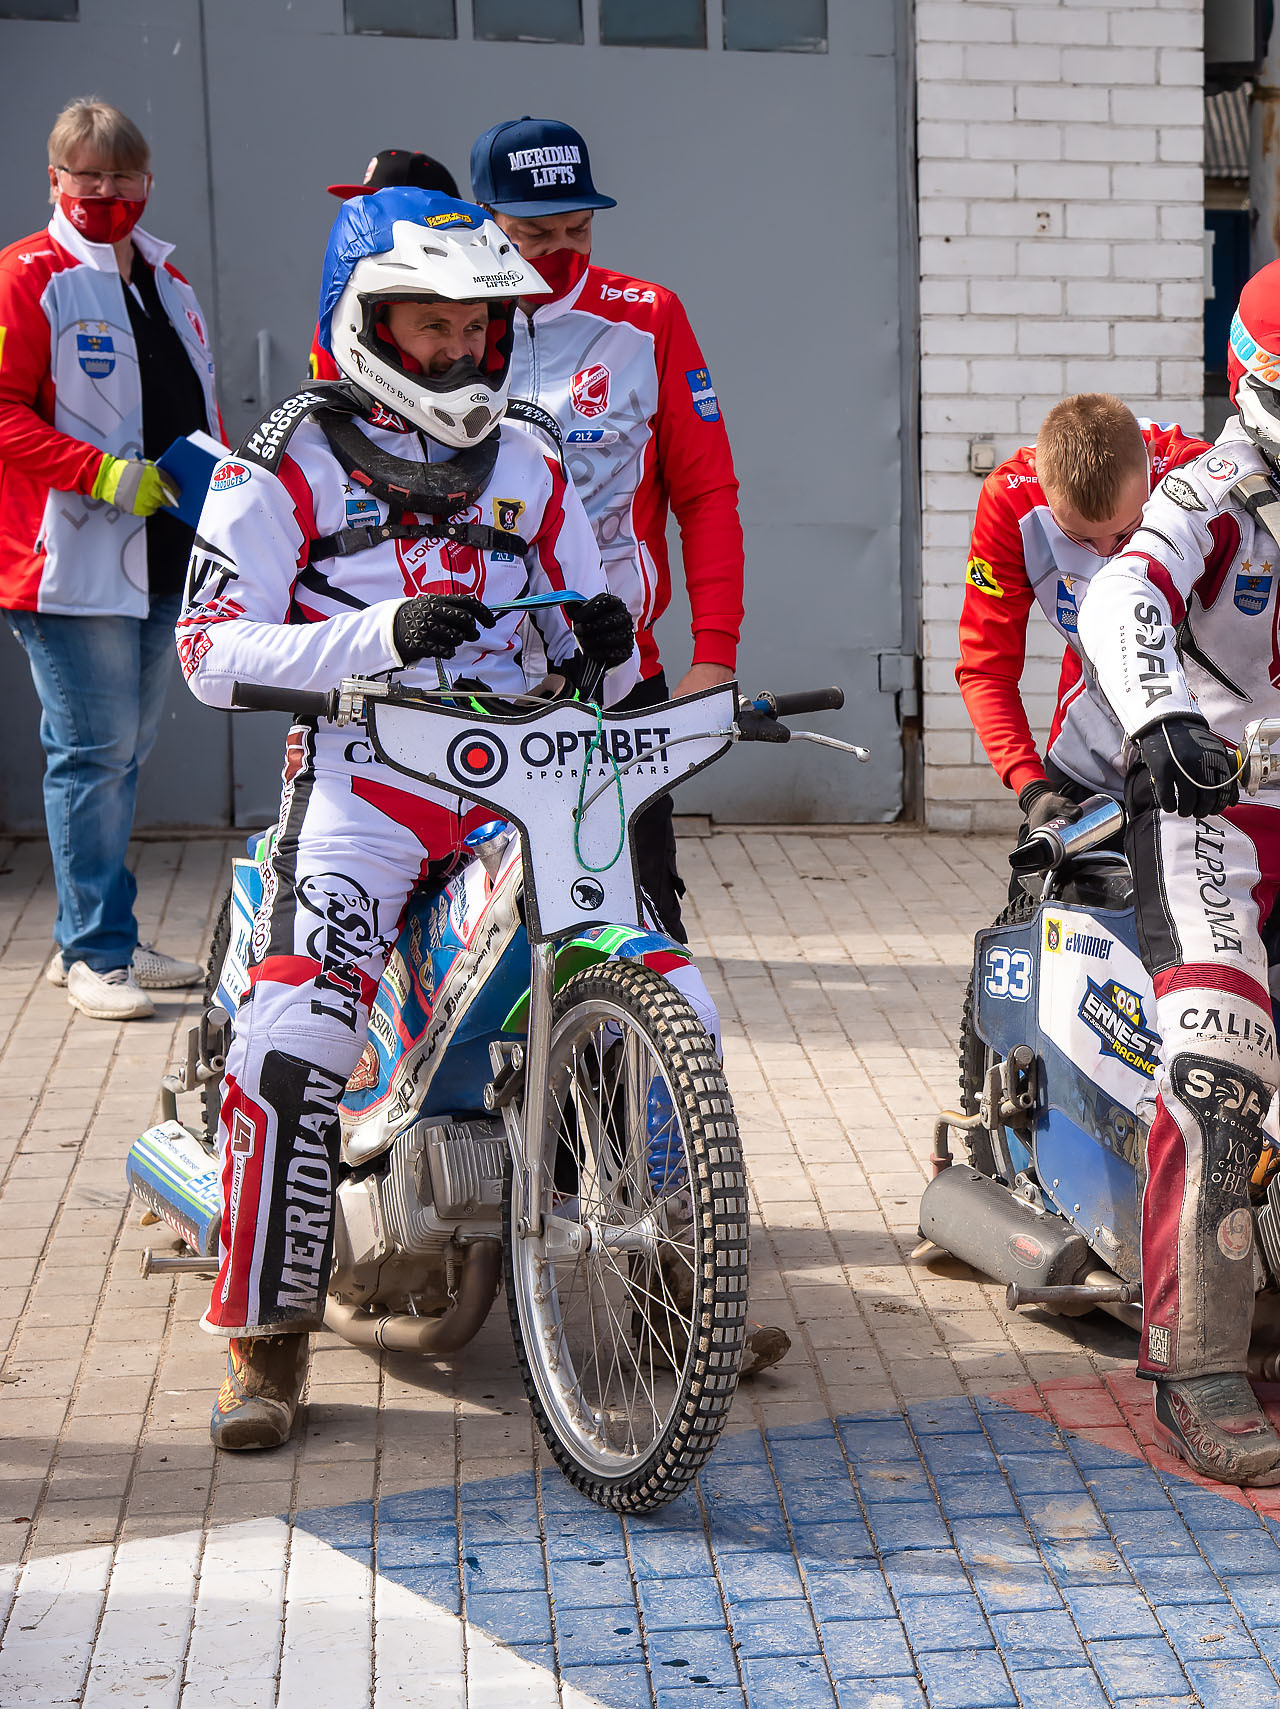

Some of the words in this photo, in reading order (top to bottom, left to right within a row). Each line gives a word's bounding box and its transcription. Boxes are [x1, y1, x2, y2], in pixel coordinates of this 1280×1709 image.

[507, 145, 581, 171] MERIDIAN
[531, 165, 576, 187] LIFTS
[472, 273, 519, 284] MERIDIAN
[485, 280, 509, 289] LIFTS
[396, 389, 415, 408] Byg
[246, 391, 316, 456] HAGON
[261, 395, 327, 461] SHOCKS
[213, 474, 244, 489] PRODUCTS
[519, 727, 671, 768] OPTIBET
[526, 767, 606, 780] SPORTA
[622, 765, 670, 776] BĀRS
[1065, 930, 1114, 960] eWinner
[984, 946, 1033, 1002] 33
[1083, 991, 1162, 1059] ERNEST
[1111, 1039, 1157, 1077] RACING
[232, 1156, 243, 1205] LAURITZ
[276, 1067, 344, 1314] MERIDIAN
